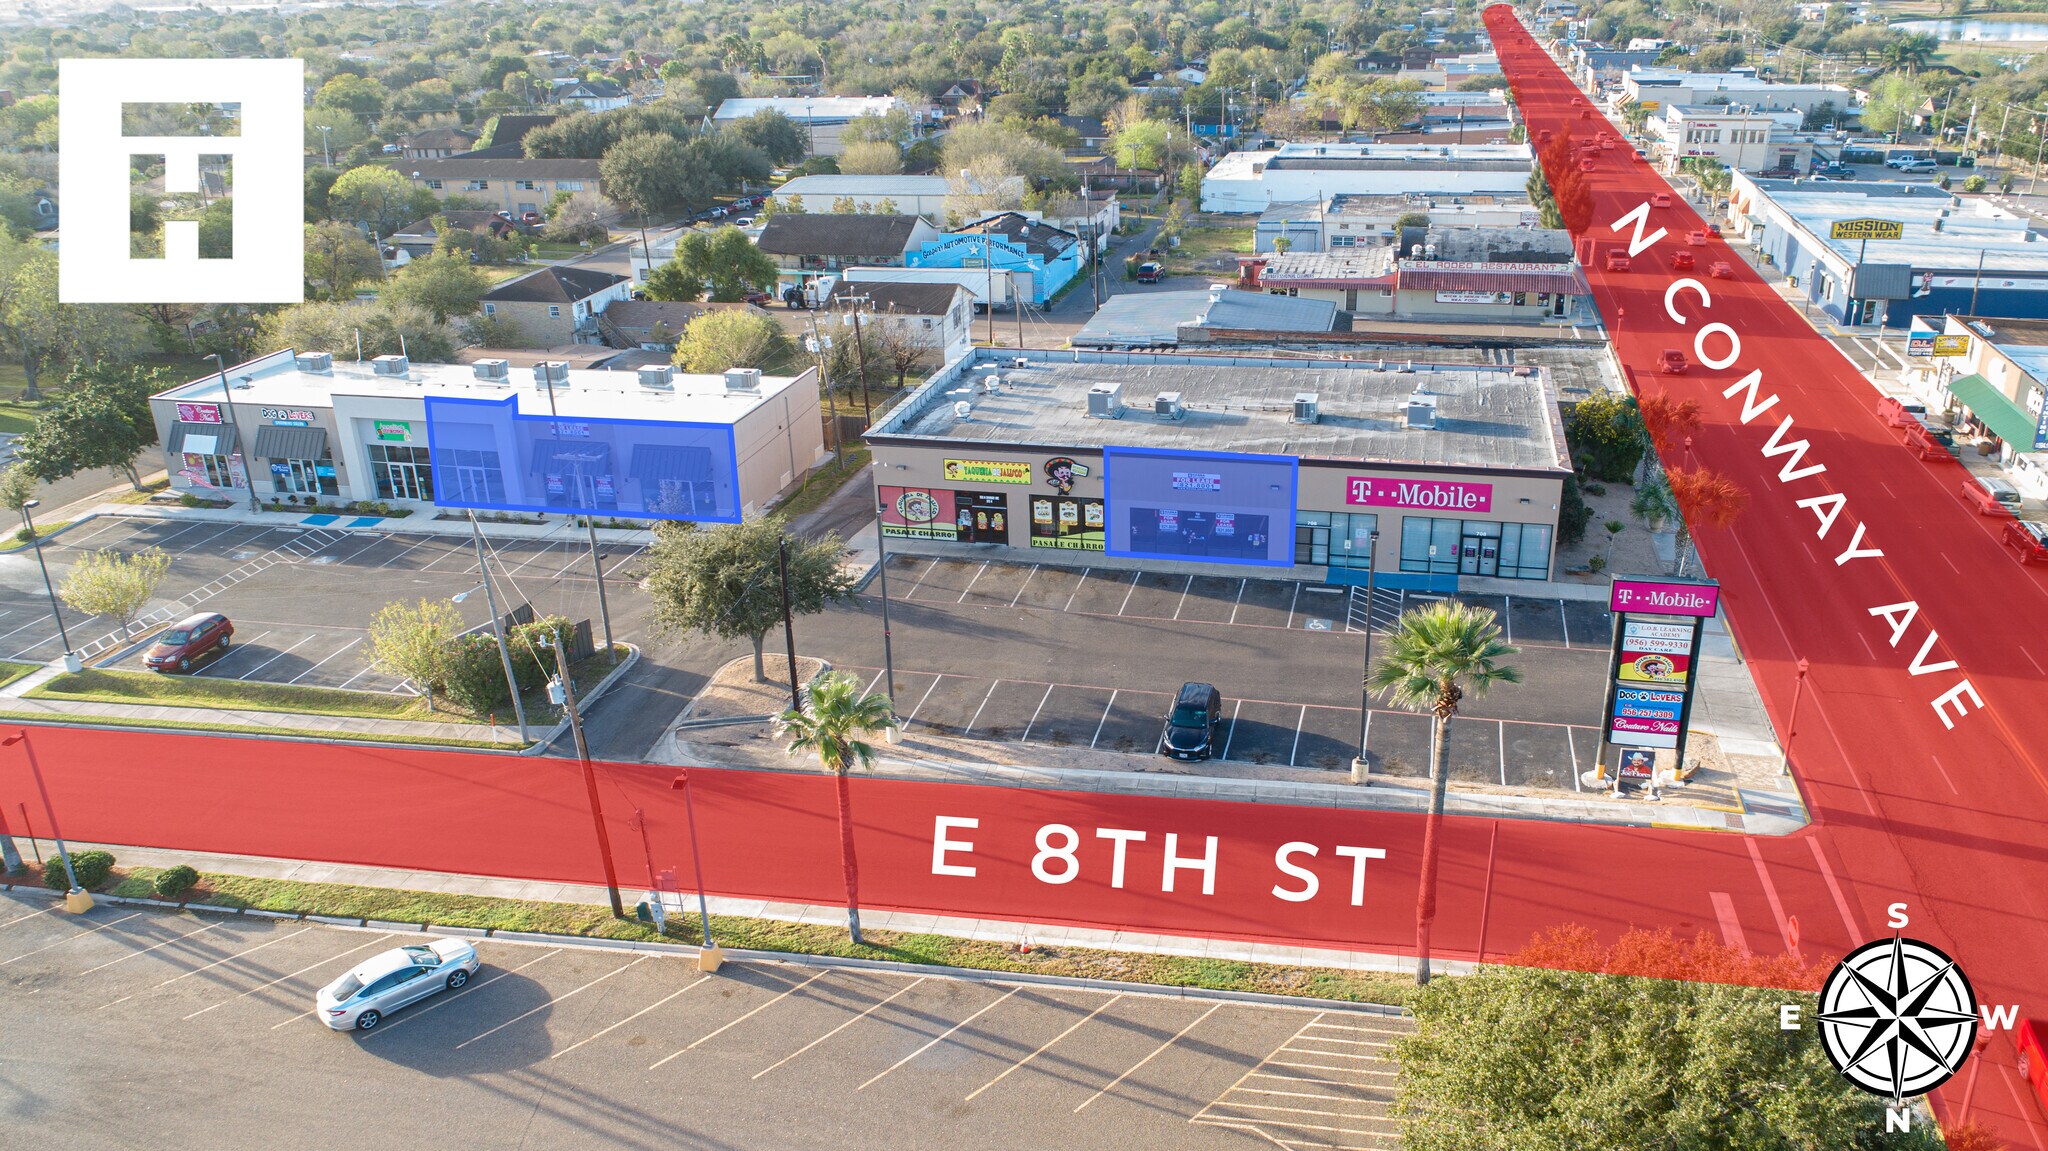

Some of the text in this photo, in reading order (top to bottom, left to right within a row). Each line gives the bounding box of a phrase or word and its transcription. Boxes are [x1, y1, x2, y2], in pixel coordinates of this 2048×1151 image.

[1838, 221, 1899, 231] MISSION
[943, 235, 981, 251] AUTOMOTIVE
[981, 236, 1025, 259] PRFORMANCE
[1480, 263, 1557, 271] RESTAURANT
[964, 466, 992, 475] TAQUERIA
[1067, 541, 1105, 550] CHARRO
[1625, 639, 1689, 649] (956) 599-9330
[1619, 691, 1683, 702] DOG LOVERS
[1614, 718, 1679, 732] Couture Nails
